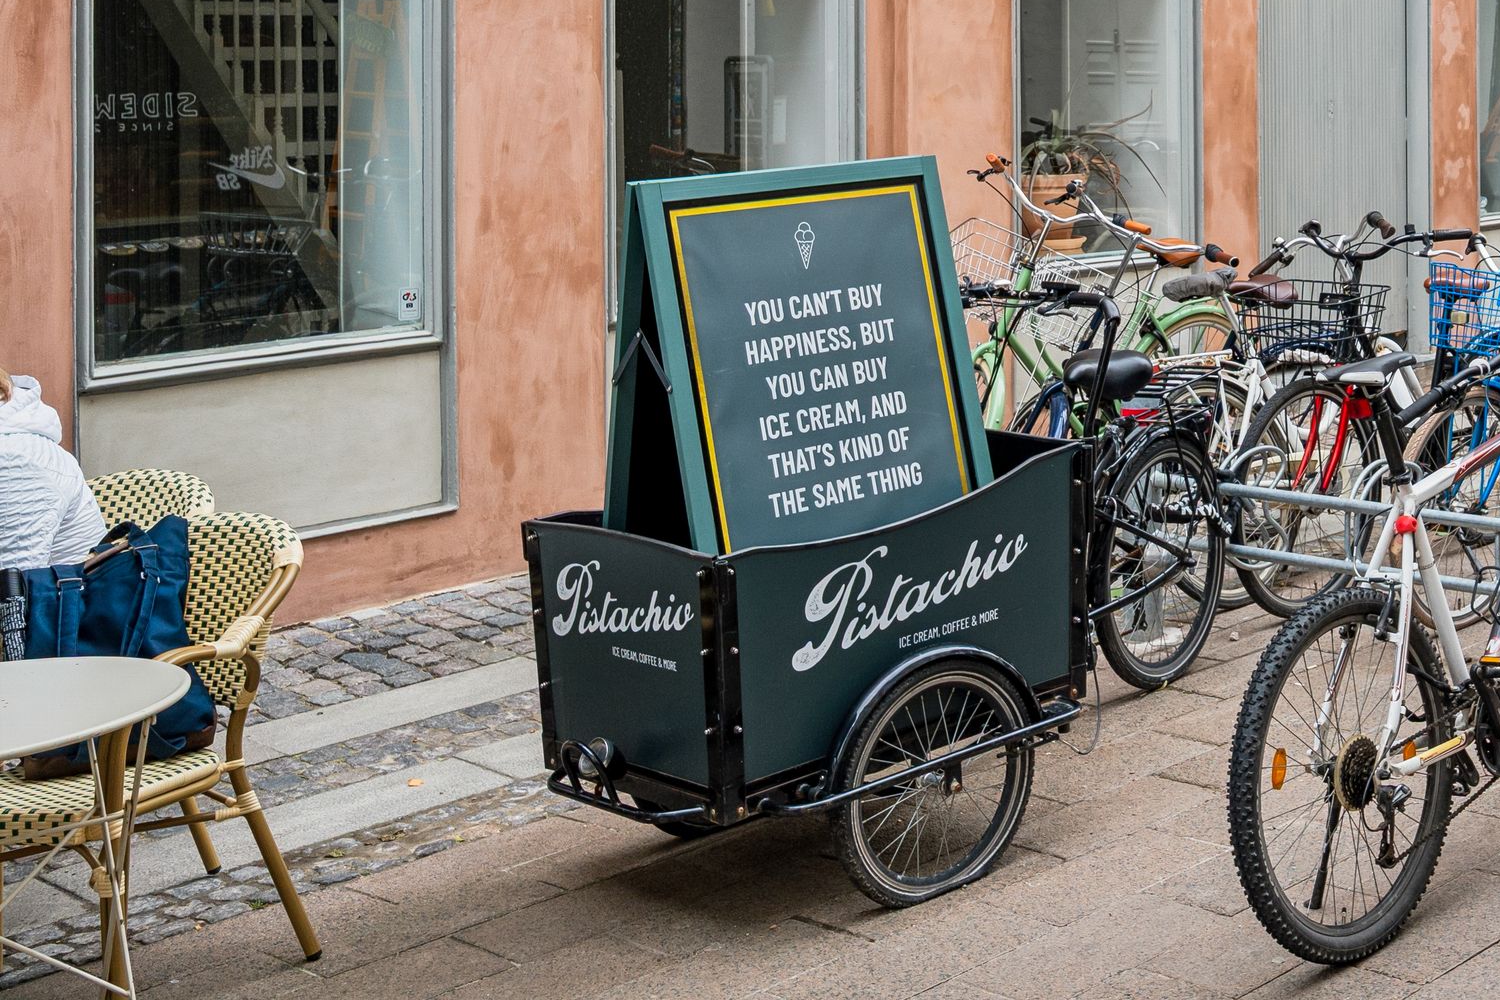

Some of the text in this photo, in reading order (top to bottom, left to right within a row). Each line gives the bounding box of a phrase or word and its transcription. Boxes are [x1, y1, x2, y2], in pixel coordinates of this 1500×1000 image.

[744, 283, 882, 326] YOU CAN'T BUY
[745, 318, 894, 366] HAPPINESS, BUT
[765, 356, 887, 400] YOU CAN BUY
[759, 391, 907, 441] ICE CREAM, AND
[767, 426, 910, 479] THAT'S KIND OF
[768, 462, 923, 518] THE SAME THING
[552, 560, 694, 637] Pistachio
[791, 533, 1028, 672] Pistachio
[898, 608, 999, 649] ICE CREAM, COFFEE & MORE
[611, 645, 678, 672] ICE CREAM, COFFEE & MORE
